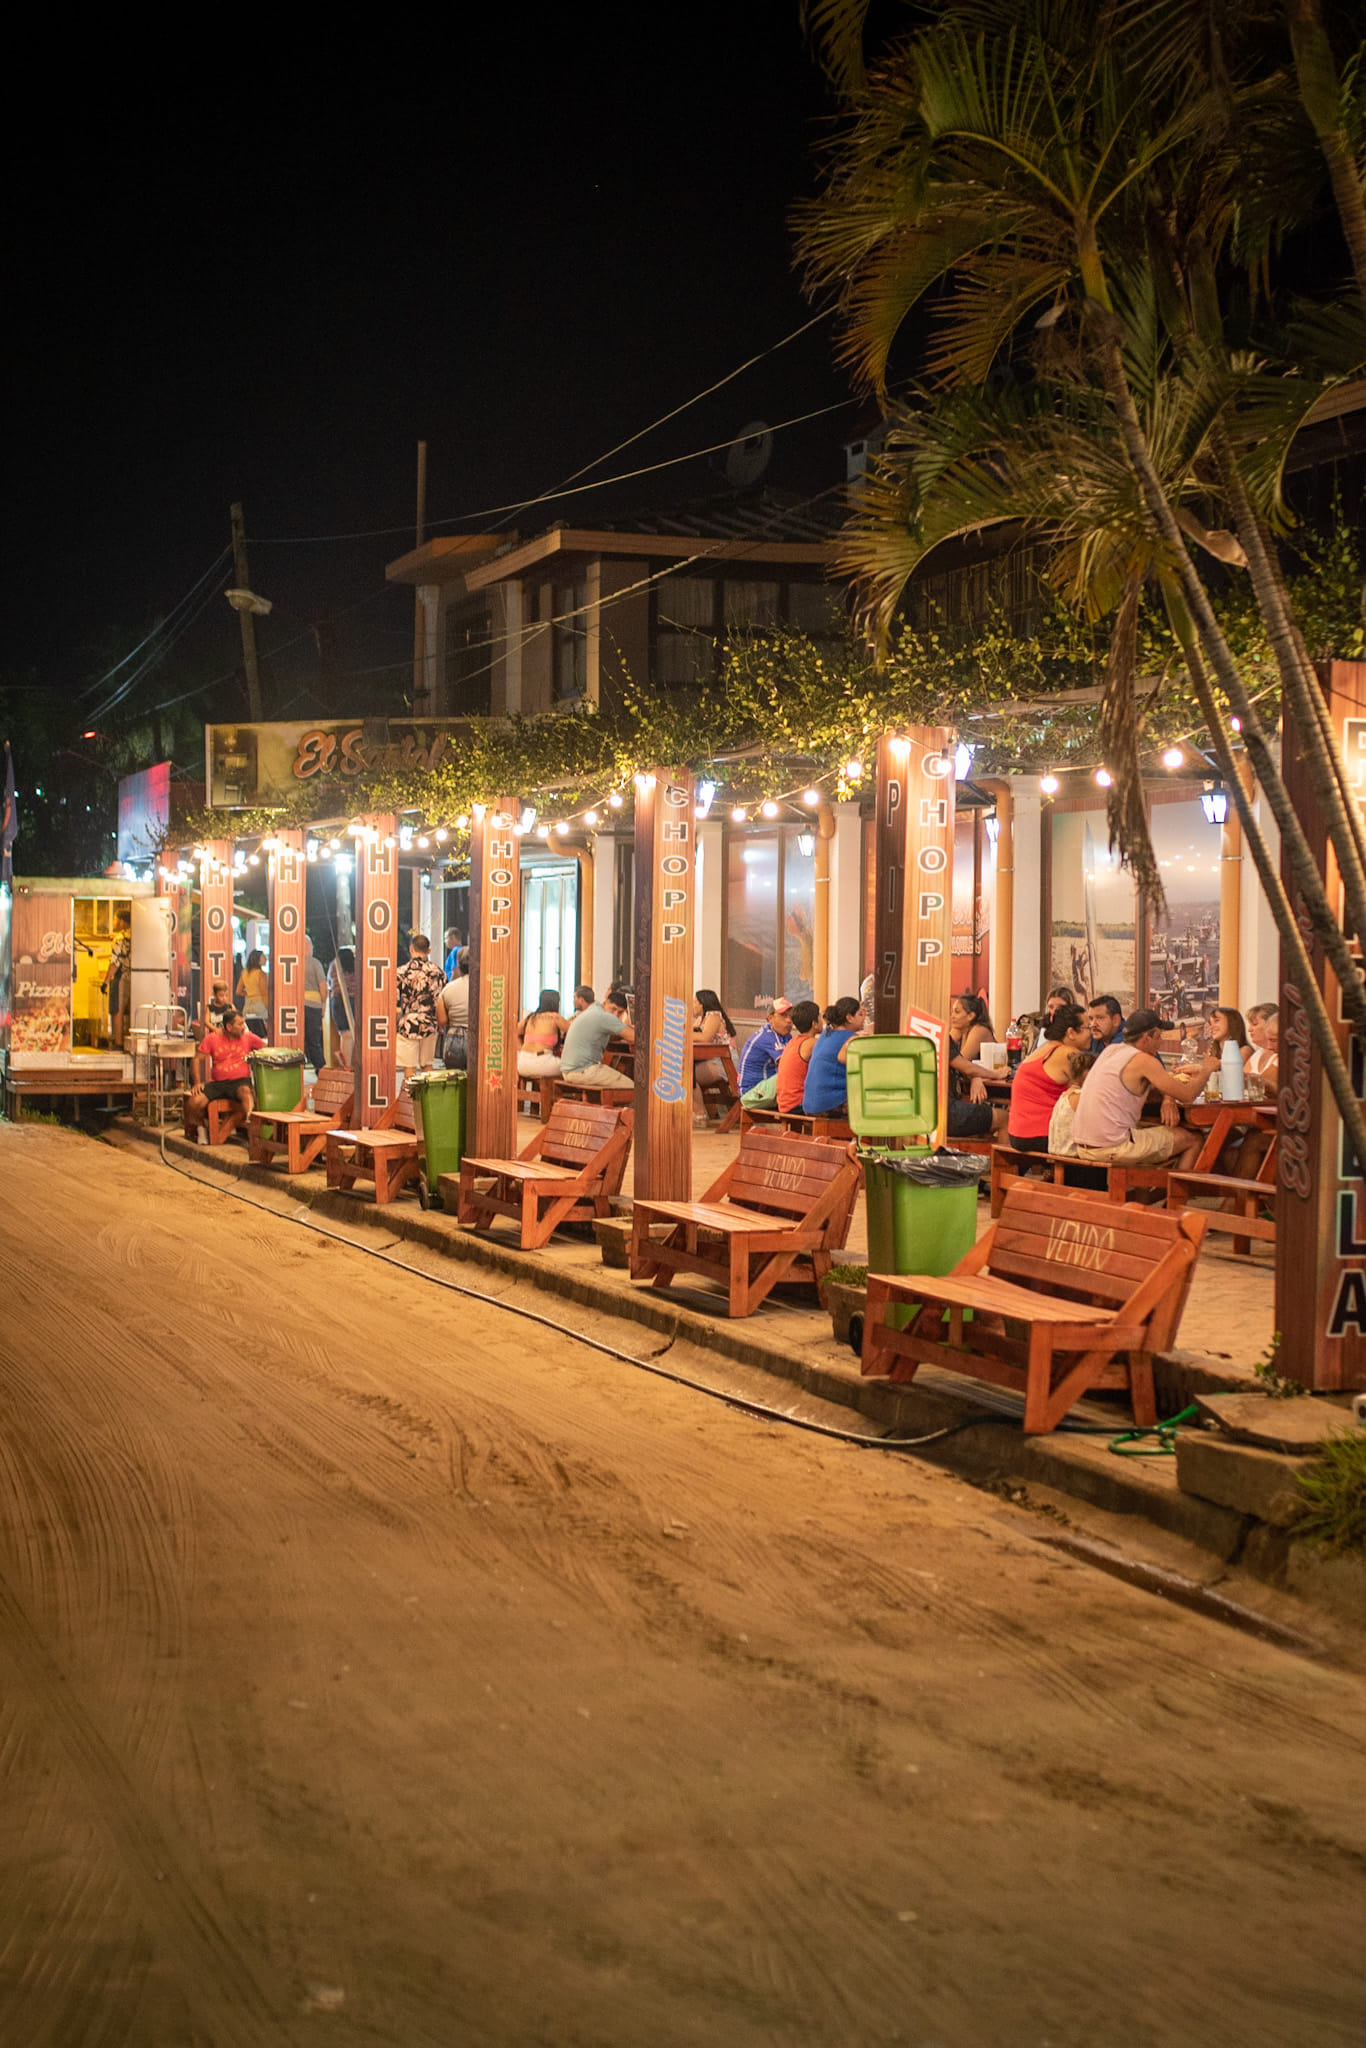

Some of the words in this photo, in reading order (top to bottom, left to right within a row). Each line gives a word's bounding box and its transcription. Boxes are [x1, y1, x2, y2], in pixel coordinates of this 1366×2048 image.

[293, 729, 338, 779] El
[488, 812, 514, 943] CHOPP
[661, 786, 690, 945] CHOPP
[916, 751, 948, 967] CHOPP
[14, 980, 71, 999] Pizzas
[277, 850, 300, 1036] HOTE
[366, 839, 392, 1109] HOTEL
[487, 975, 505, 1071] Heineken
[652, 995, 689, 1103] Quilmes
[763, 1153, 807, 1192] VENDO
[1278, 1134, 1312, 1199] El
[1045, 1216, 1116, 1272] VENDO
